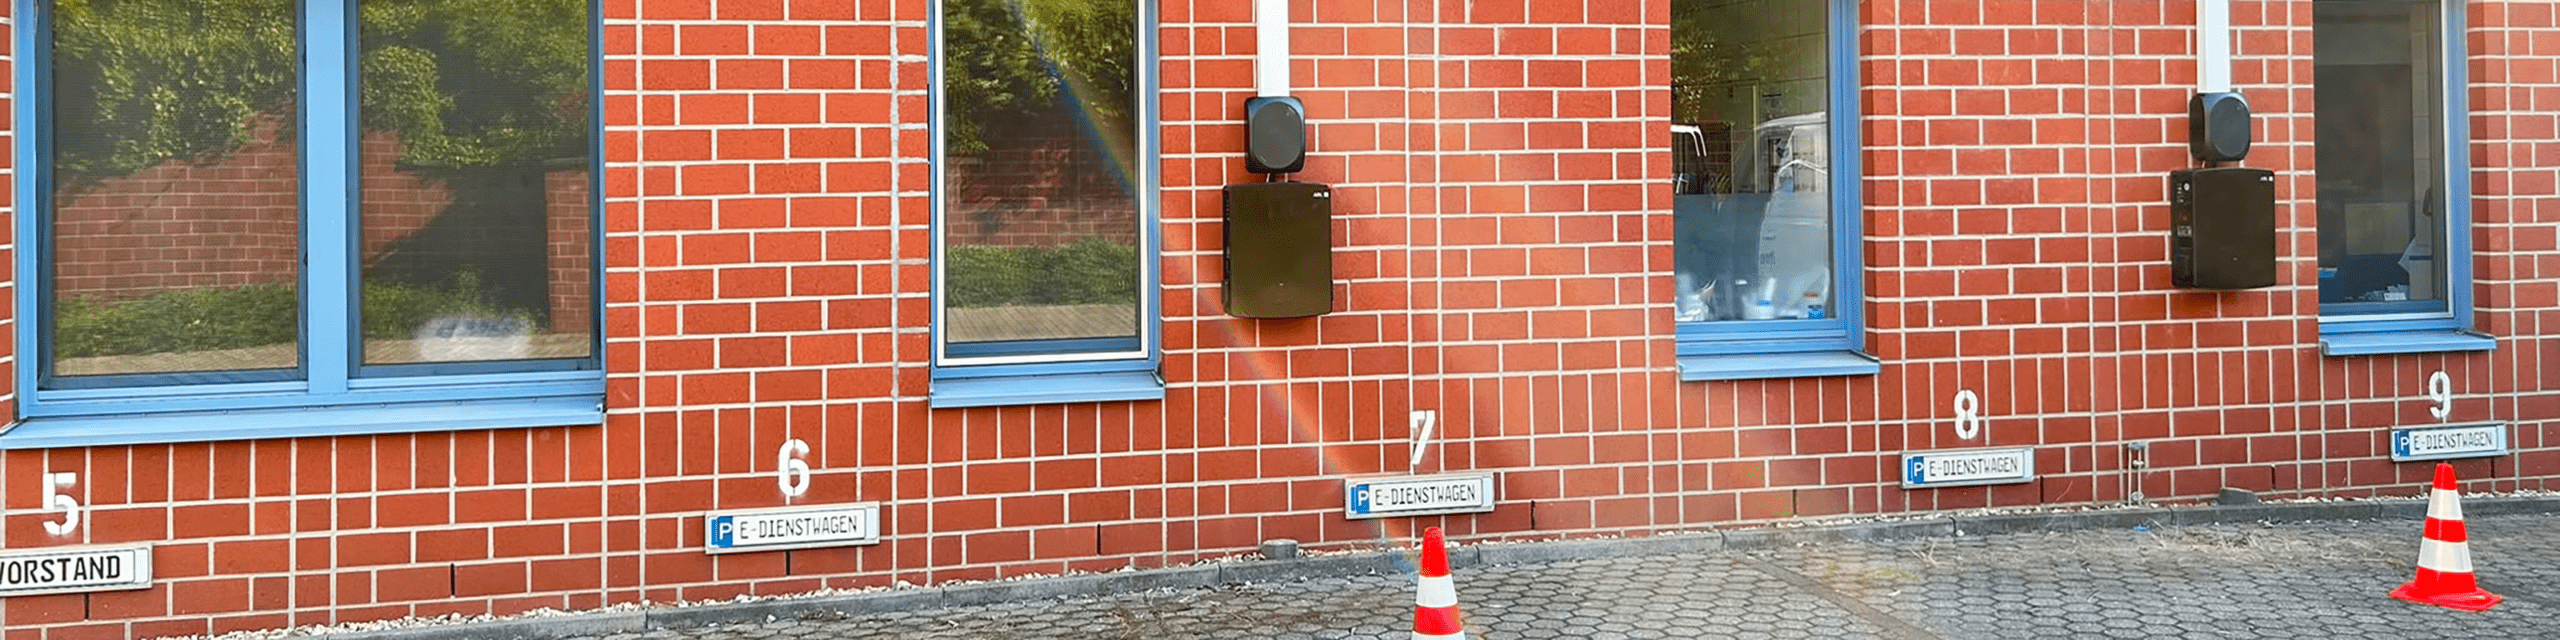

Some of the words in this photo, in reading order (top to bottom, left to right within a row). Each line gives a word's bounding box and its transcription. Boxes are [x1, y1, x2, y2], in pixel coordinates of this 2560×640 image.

[1954, 389, 1979, 440] 8
[2429, 371, 2451, 419] 9
[1410, 410, 1436, 466] 7
[2400, 436, 2410, 451] P
[2414, 431, 2493, 451] E-DIENSTWAGEN
[778, 439, 810, 497] 6
[1913, 461, 1925, 478] P
[1929, 457, 2018, 477] E-DIENSTWAGEN
[43, 472, 79, 536] 5
[1358, 490, 1370, 507] P
[1375, 484, 1476, 507] E-DIENSTWAGEN
[719, 523, 733, 540] P
[740, 515, 858, 540] E-DIENSTWAGEN
